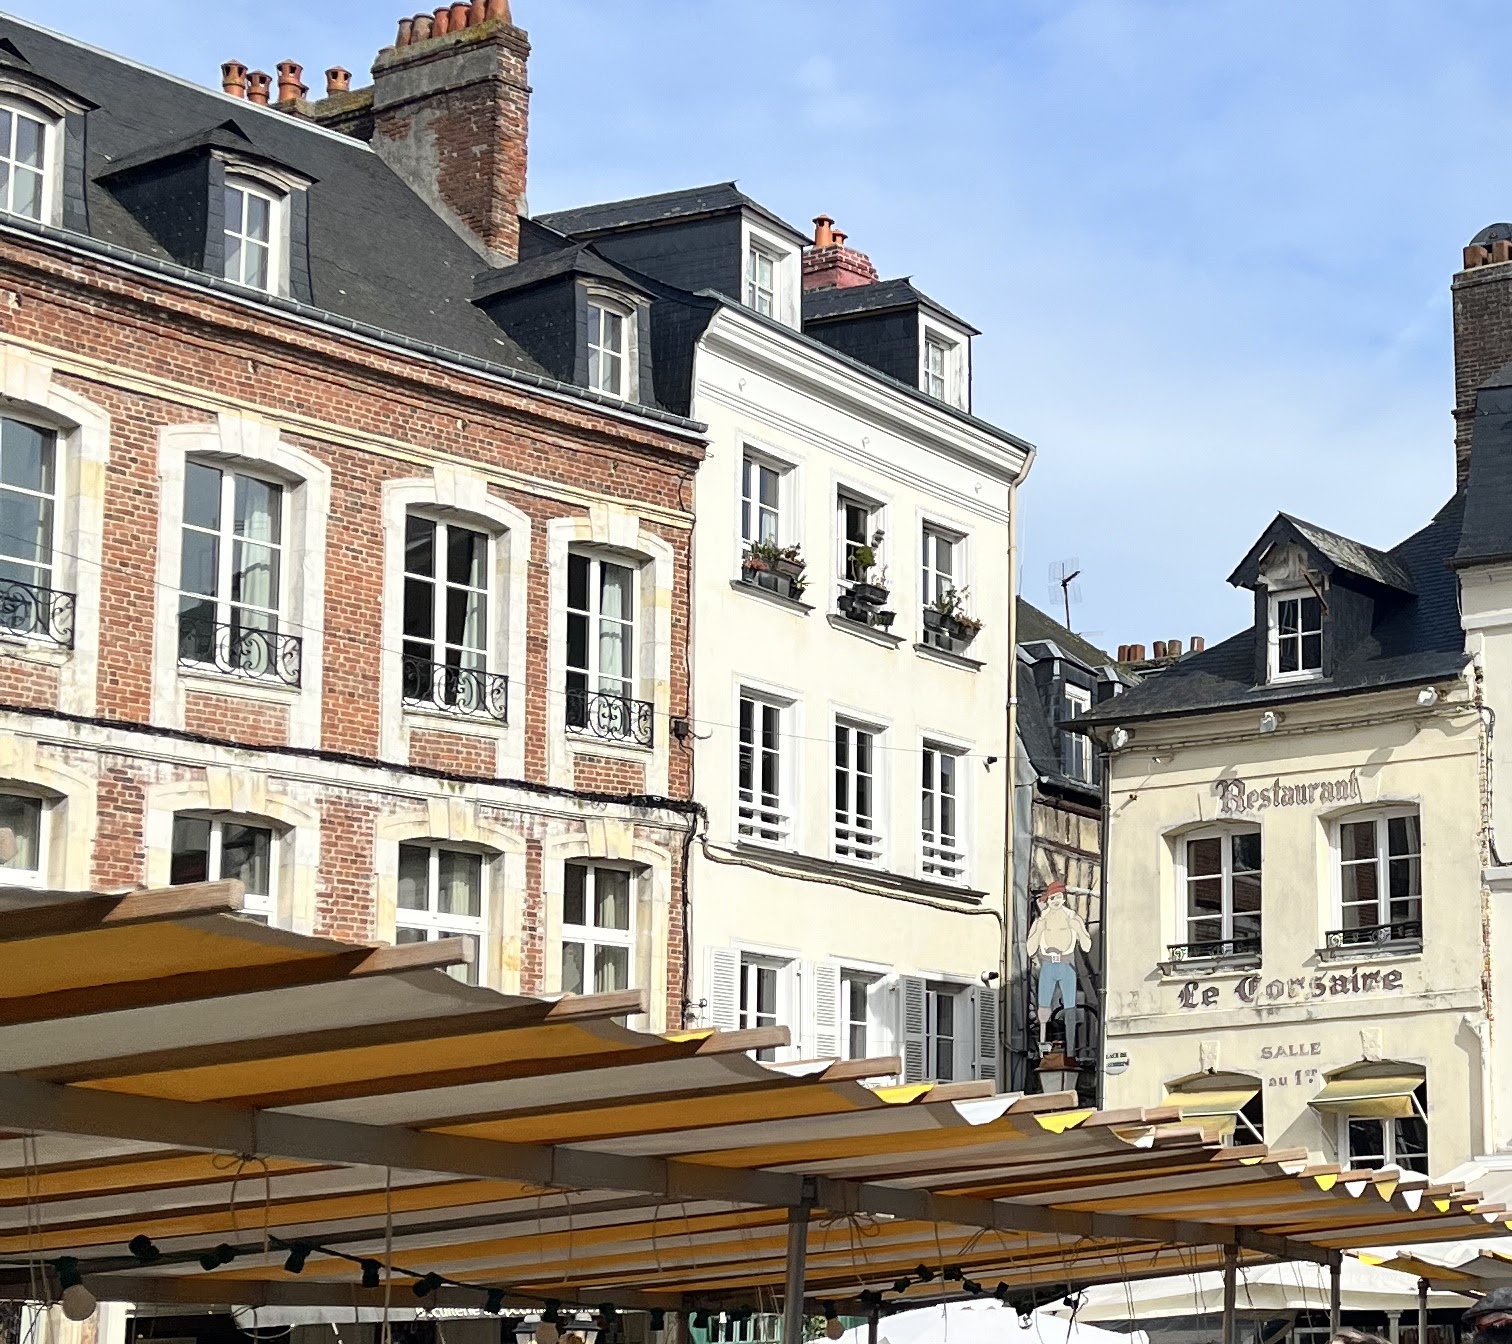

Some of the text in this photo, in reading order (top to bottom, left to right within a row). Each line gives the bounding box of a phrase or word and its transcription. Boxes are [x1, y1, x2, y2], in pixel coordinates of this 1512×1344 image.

[1214, 768, 1360, 813] Restaurant
[1178, 966, 1404, 1008] Le Corsaire
[1260, 1041, 1321, 1060] SALLE
[1268, 1075, 1288, 1087] au
